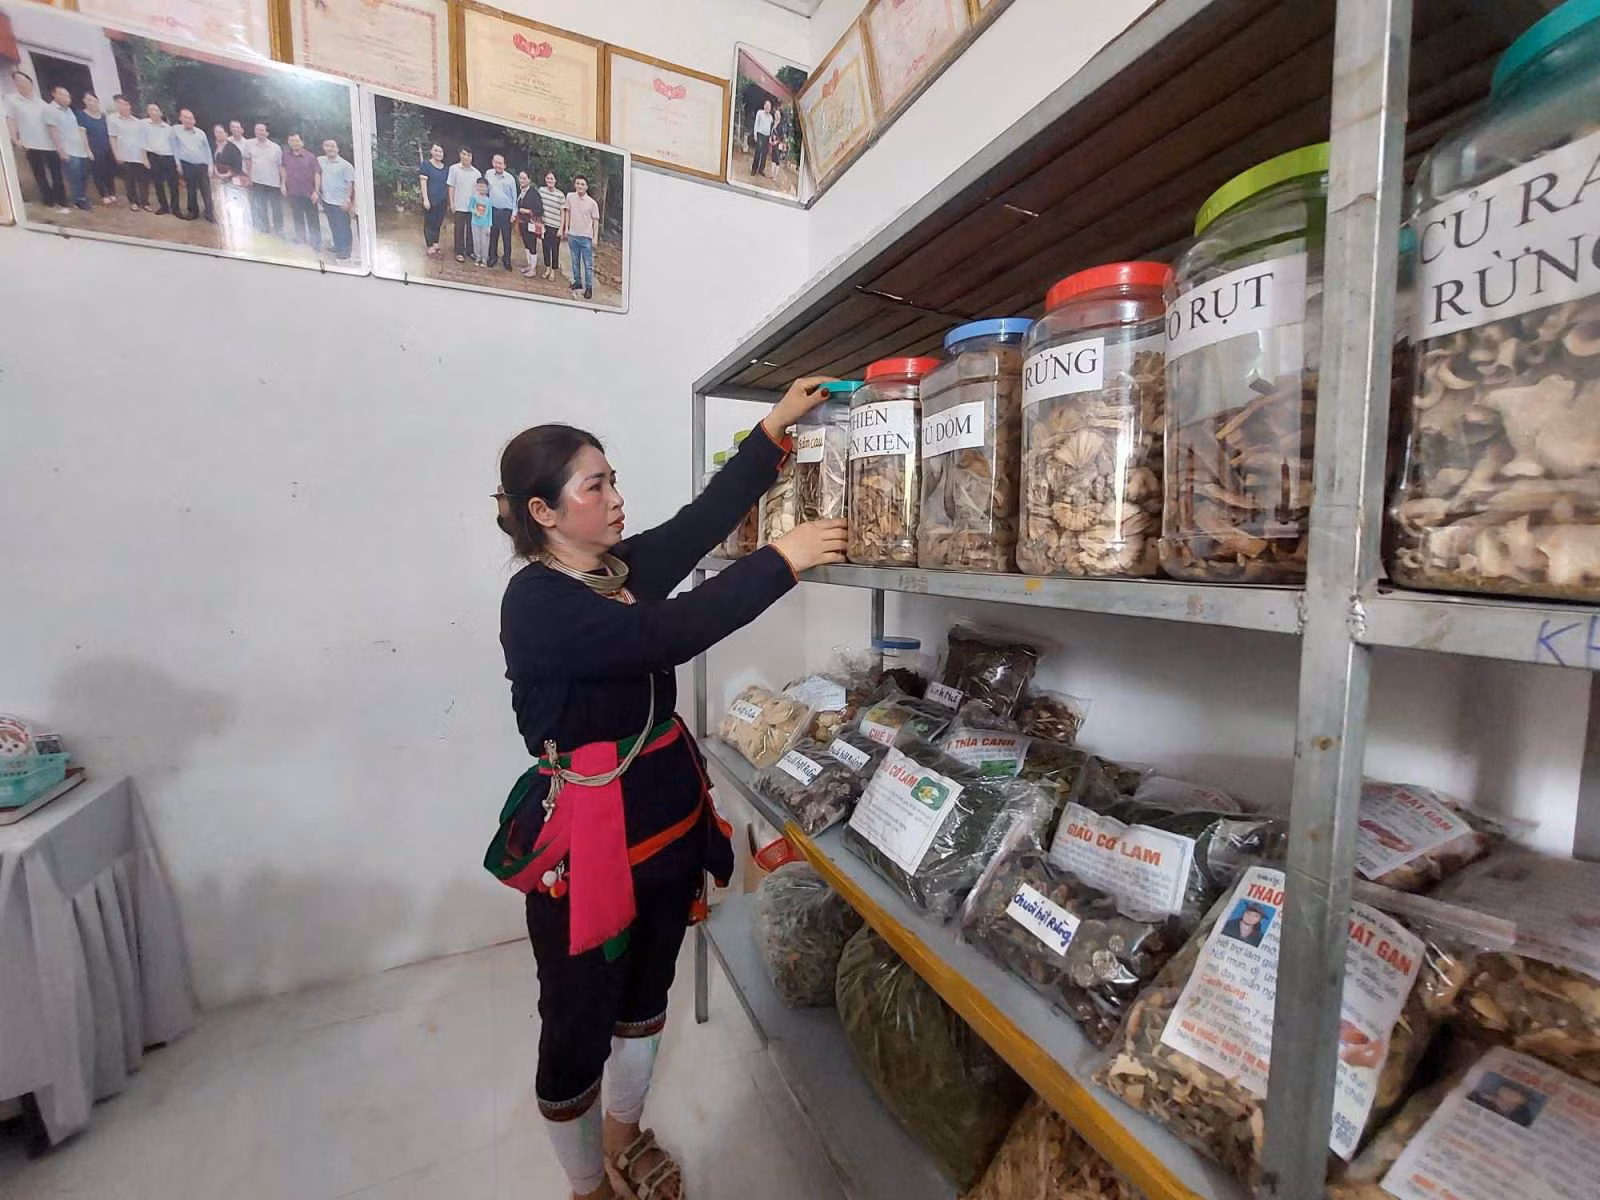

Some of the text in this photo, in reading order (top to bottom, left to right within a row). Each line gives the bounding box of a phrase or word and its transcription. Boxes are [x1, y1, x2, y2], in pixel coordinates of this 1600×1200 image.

[1430, 233, 1600, 324] RỪN
[1189, 272, 1274, 331] RỤT
[1025, 348, 1098, 391] RỪNG
[864, 431, 910, 454] KIỆN
[981, 737, 1017, 748] CANH
[1119, 842, 1162, 866] LAM
[1377, 940, 1413, 977] GAN
